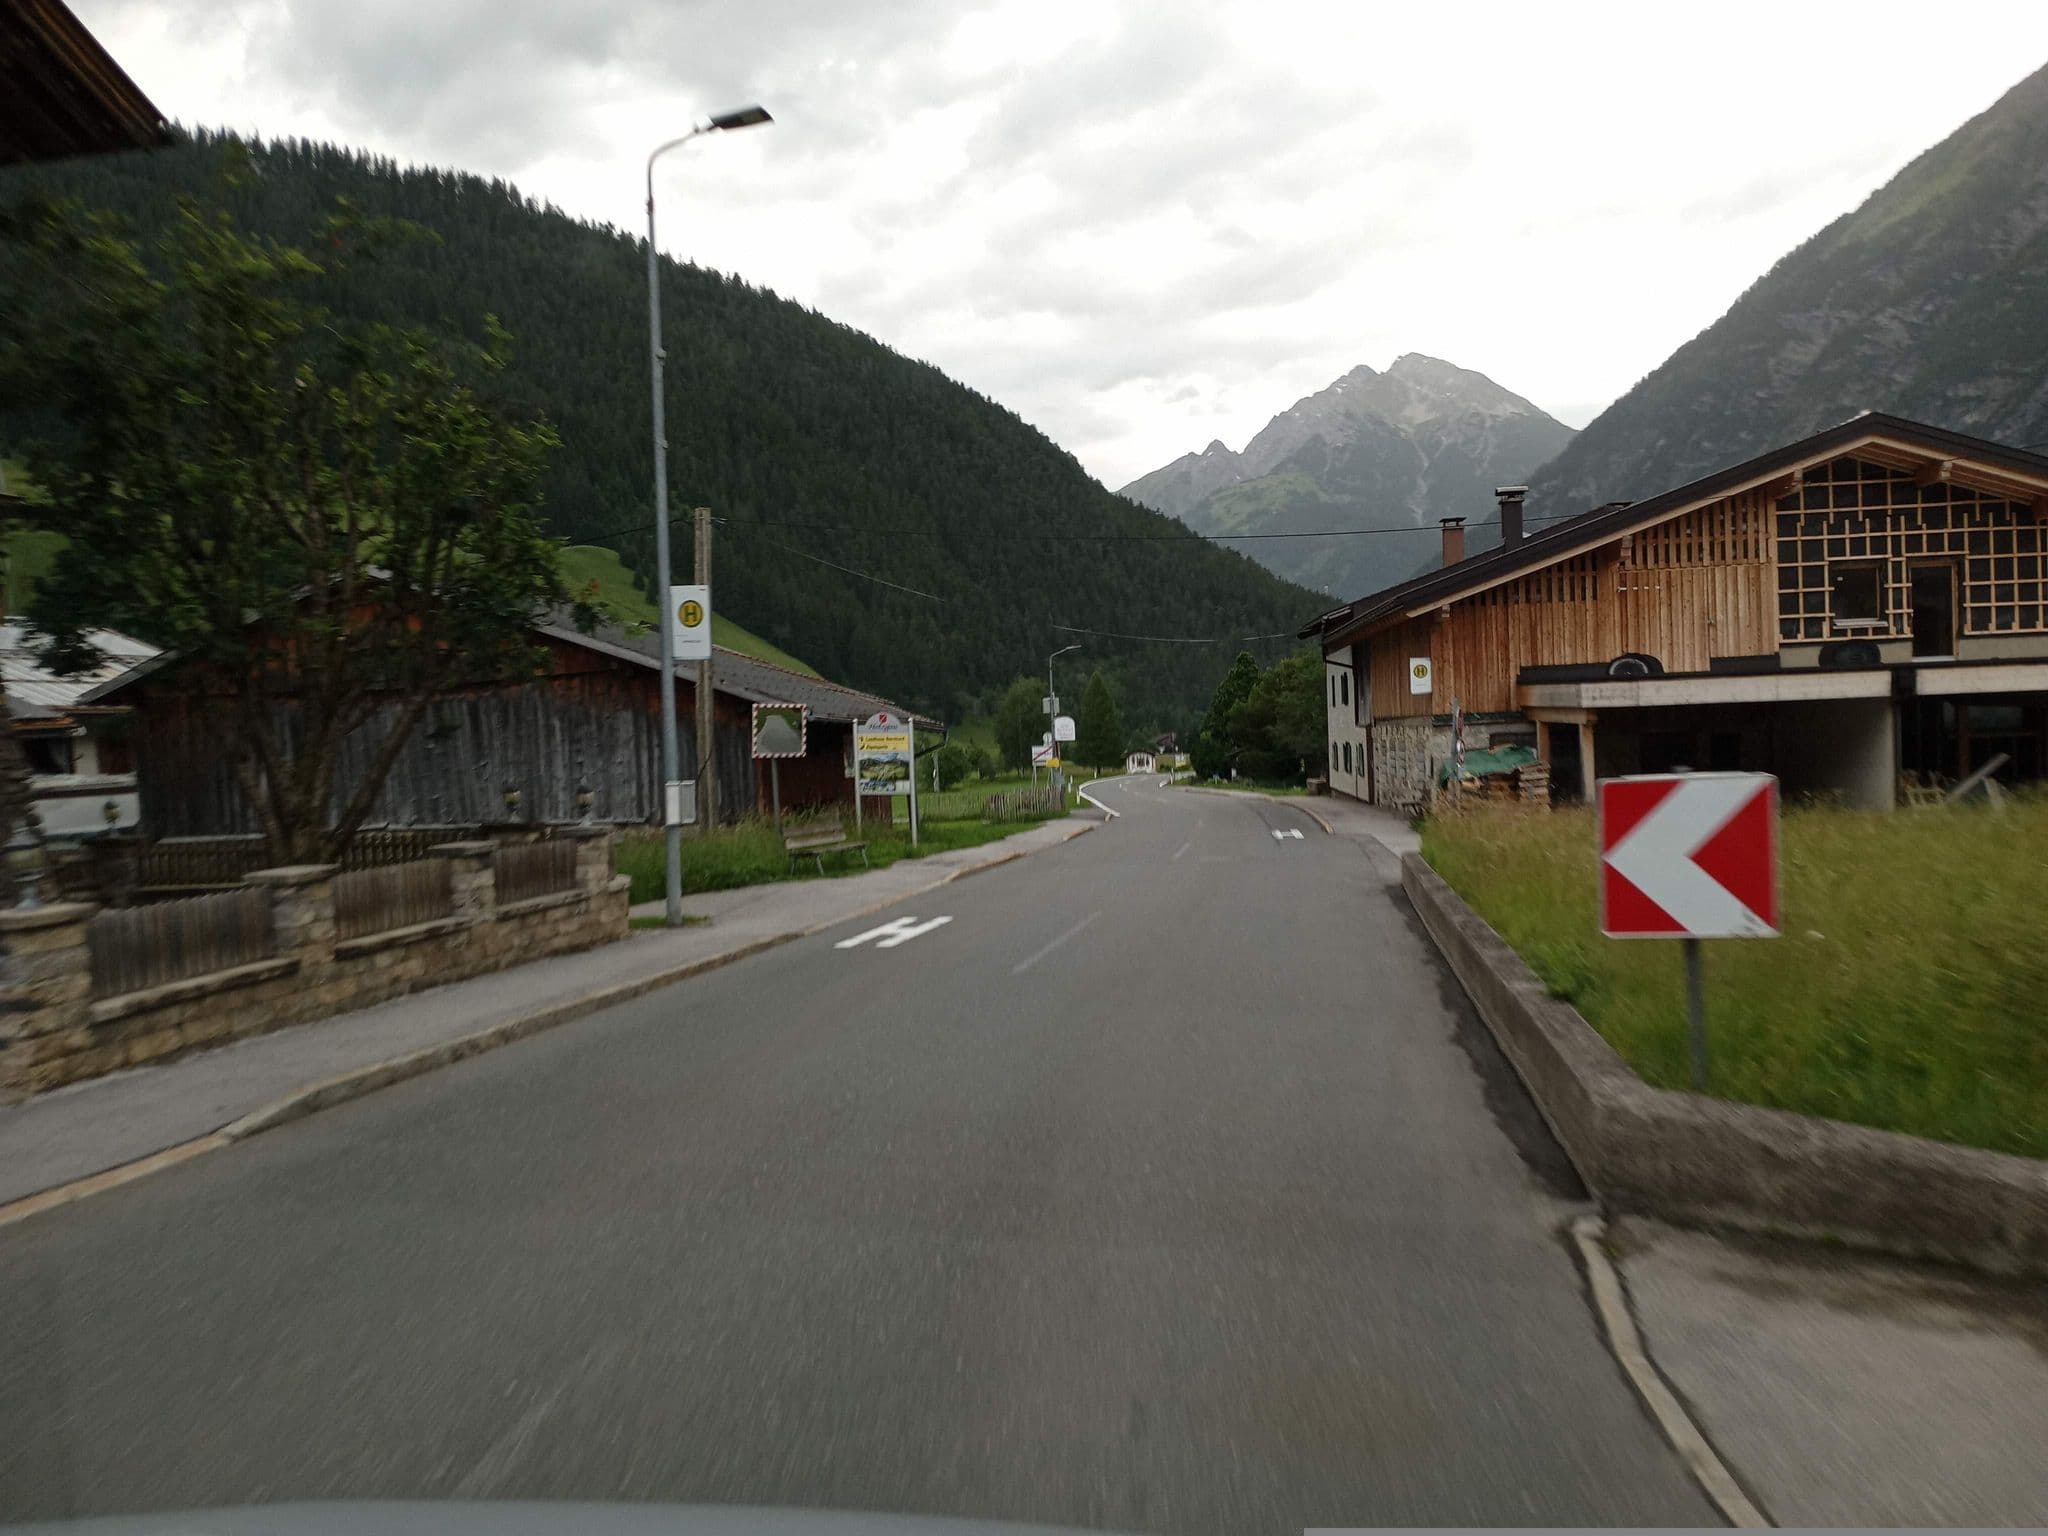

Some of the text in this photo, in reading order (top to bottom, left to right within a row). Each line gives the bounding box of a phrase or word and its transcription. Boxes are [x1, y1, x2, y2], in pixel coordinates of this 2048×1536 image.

[685, 605, 698, 622] H
[1271, 828, 1305, 840] H
[834, 916, 954, 949] H
